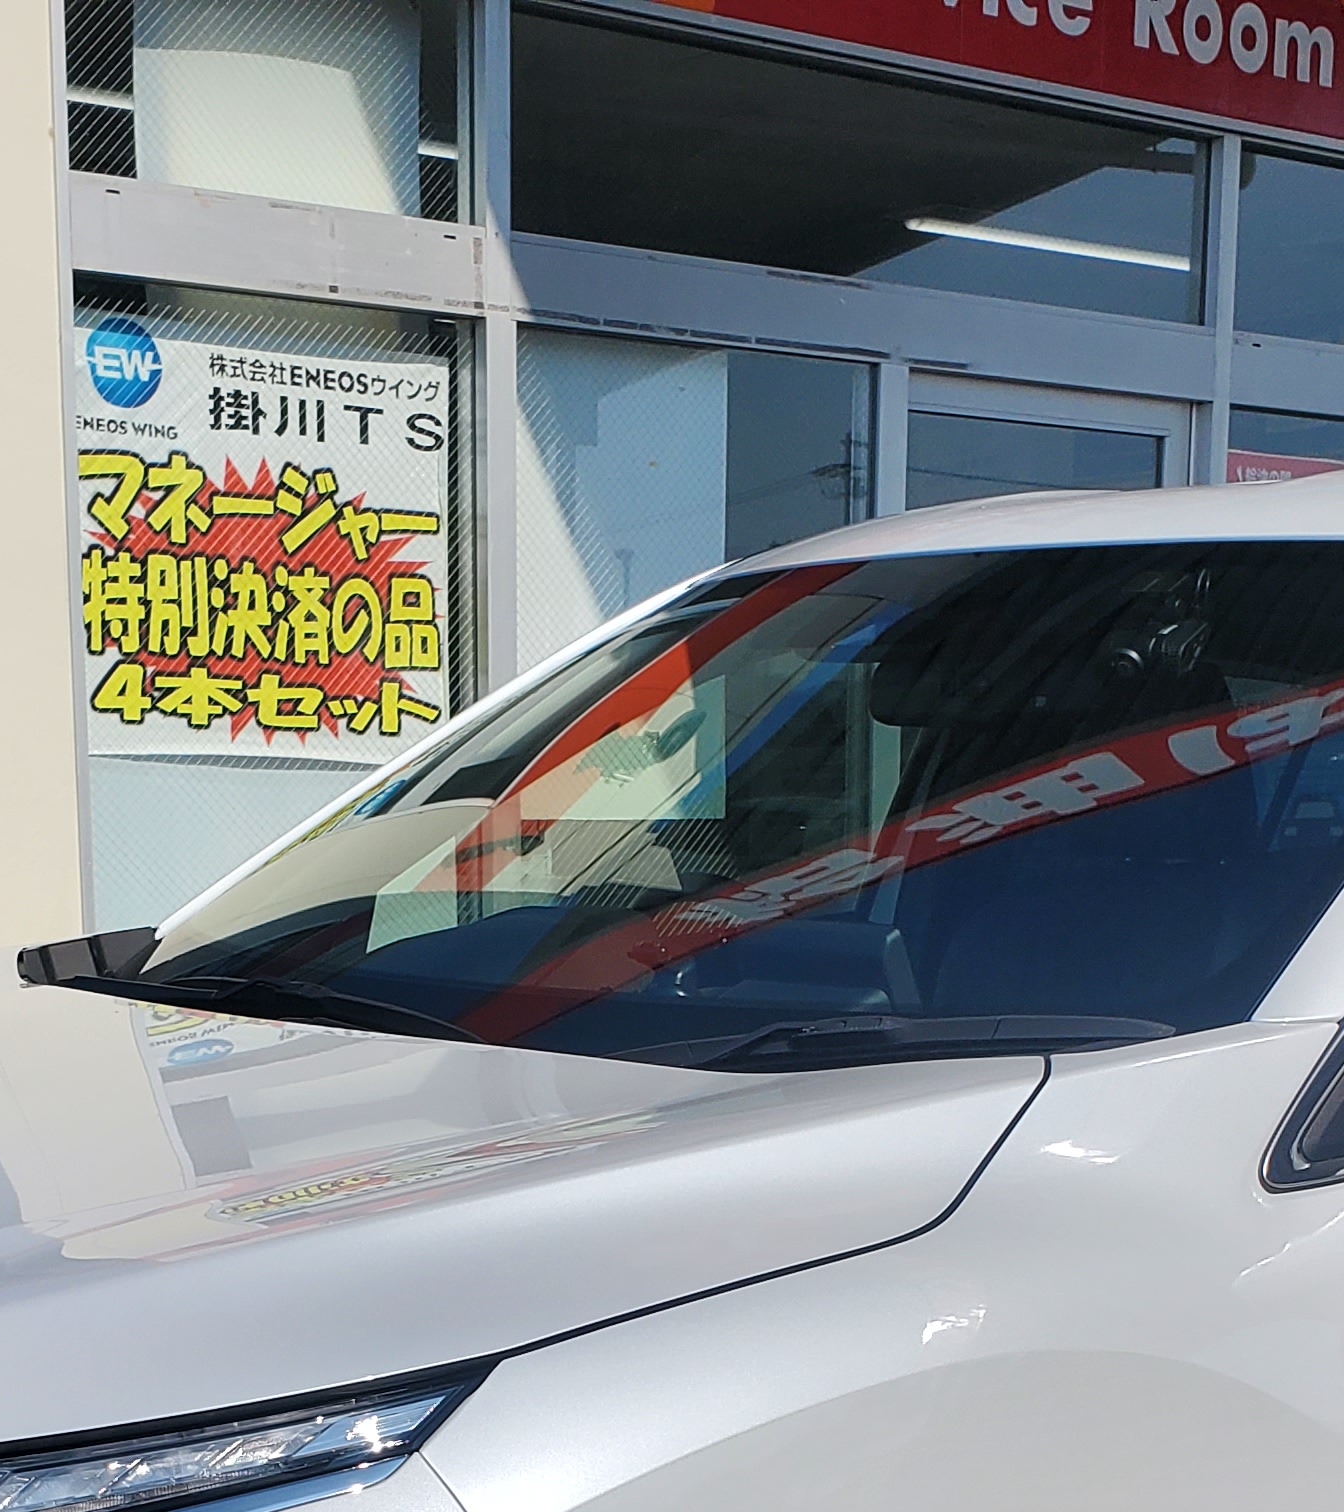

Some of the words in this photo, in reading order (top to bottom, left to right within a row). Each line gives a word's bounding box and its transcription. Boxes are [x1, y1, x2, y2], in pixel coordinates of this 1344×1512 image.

[131, 423, 178, 441] WING
[78, 449, 441, 561] マネージャー
[81, 546, 442, 673] 特別決済の品
[90, 662, 443, 737] 4本セット
